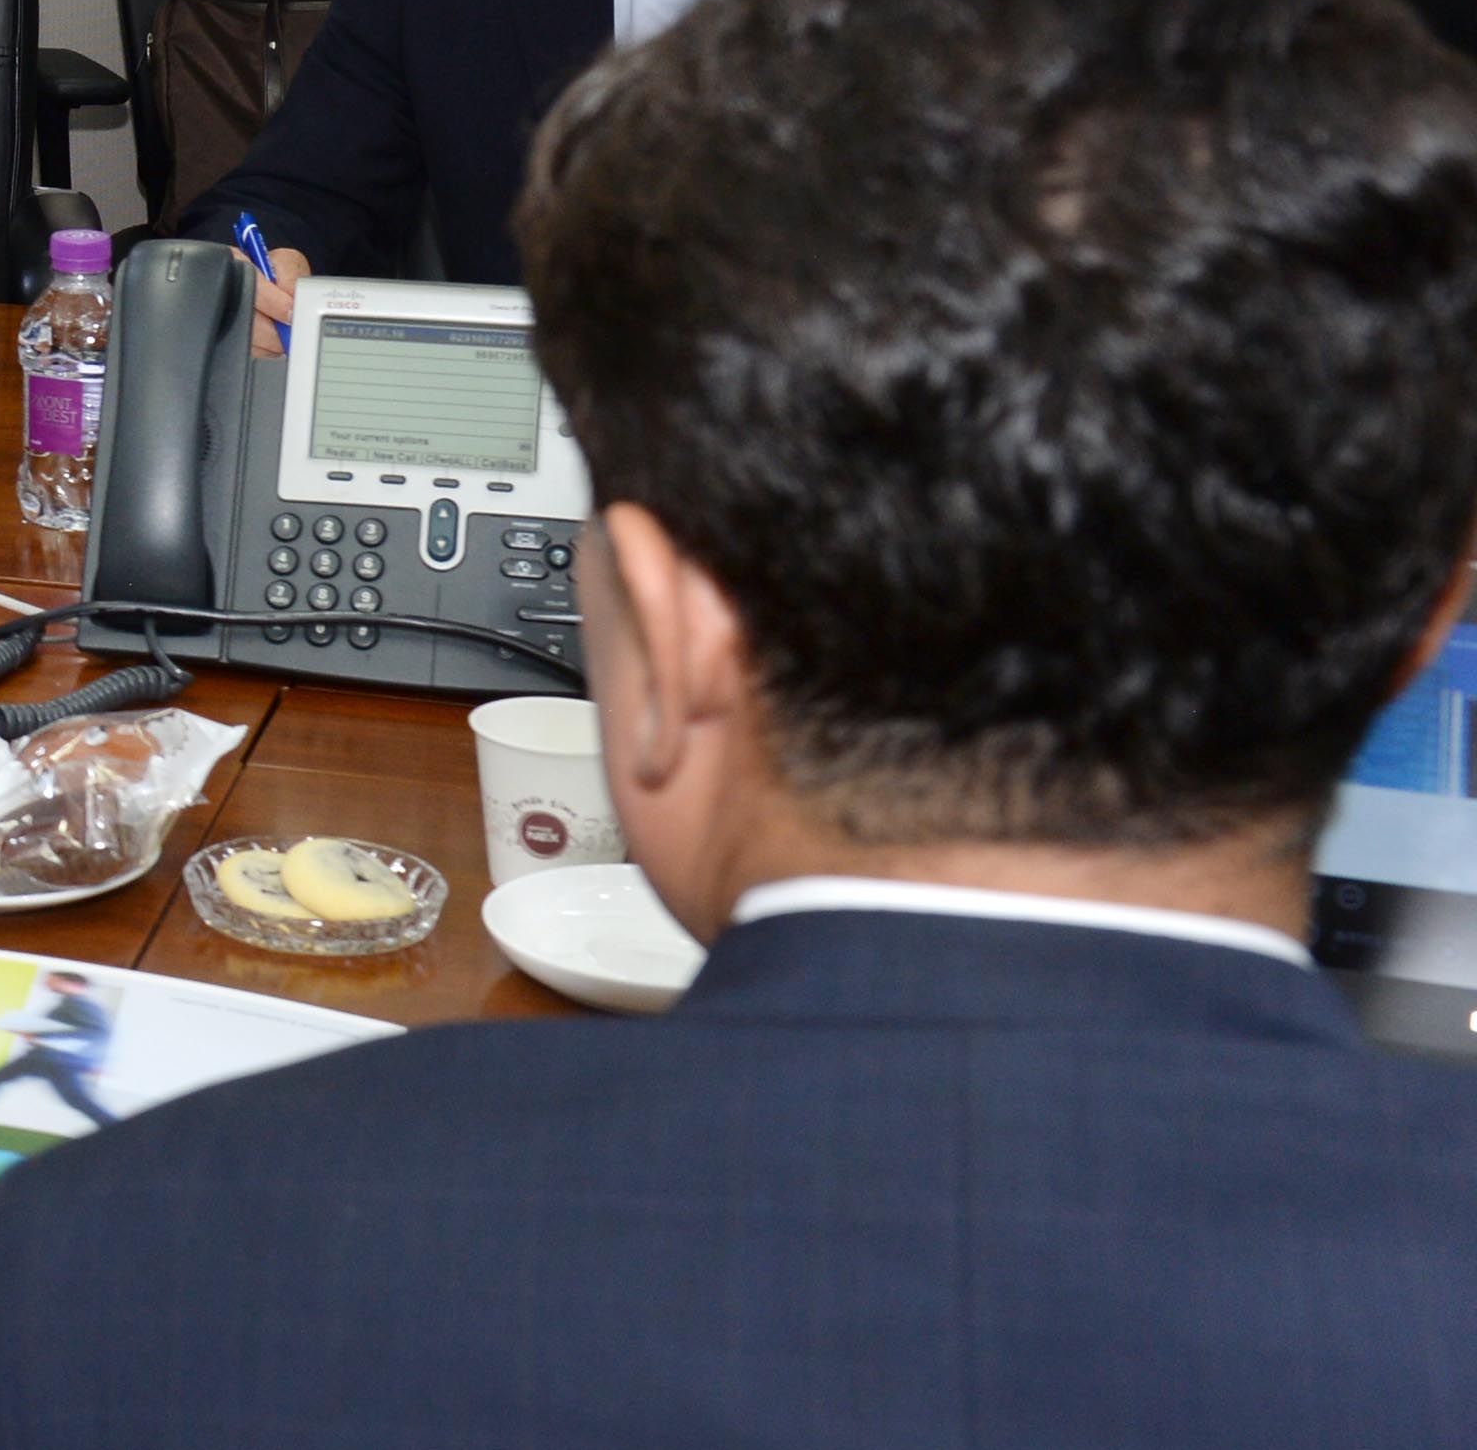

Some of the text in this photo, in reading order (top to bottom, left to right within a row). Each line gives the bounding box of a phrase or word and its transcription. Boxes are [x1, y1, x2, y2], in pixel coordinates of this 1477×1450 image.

[44, 410, 78, 424] BEST
[282, 517, 377, 535] 1 2 3
[277, 551, 374, 568] 4 5 6
[276, 585, 372, 603] 7 8 9
